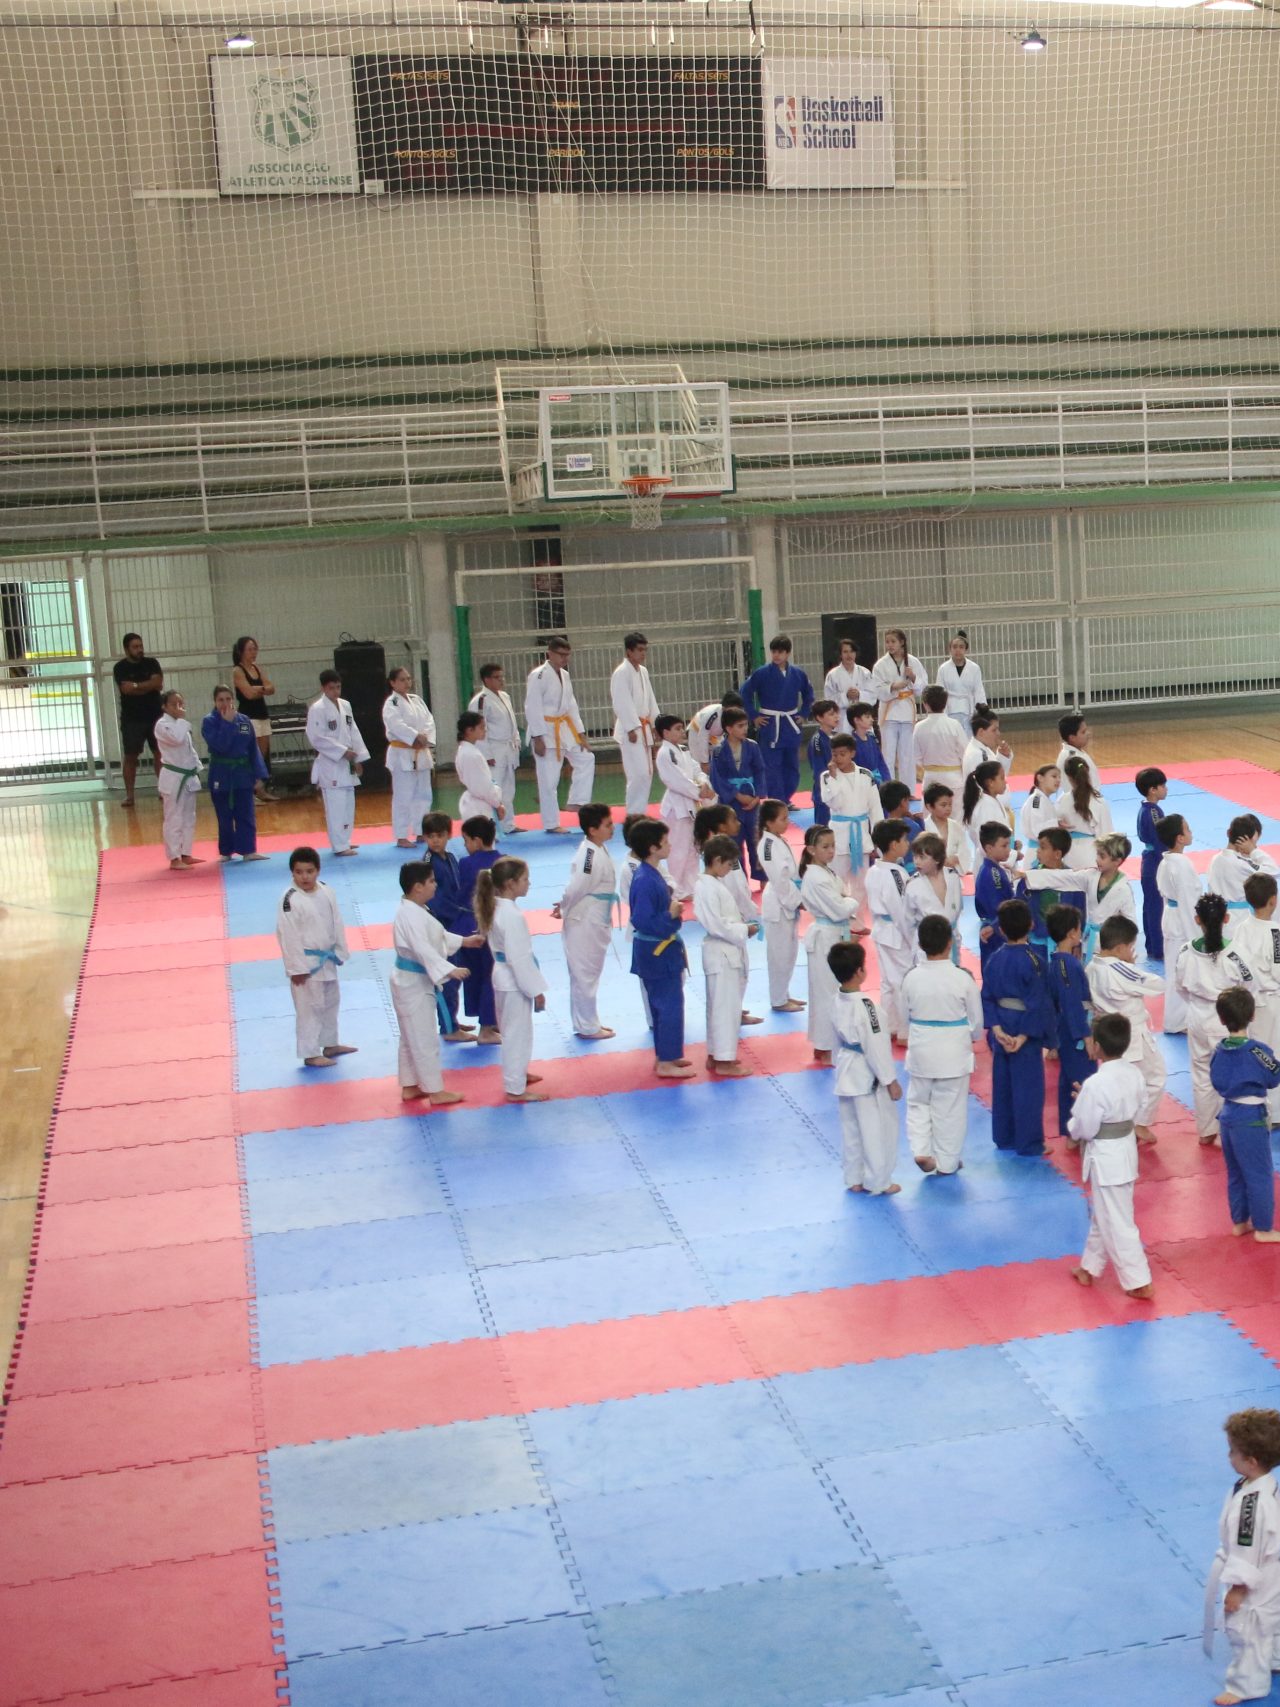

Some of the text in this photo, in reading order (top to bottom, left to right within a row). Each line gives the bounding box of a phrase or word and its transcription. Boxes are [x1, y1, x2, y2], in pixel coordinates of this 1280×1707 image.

[802, 95, 884, 122] Basketball
[803, 123, 857, 149] School
[288, 175, 353, 187] CALDENSE
